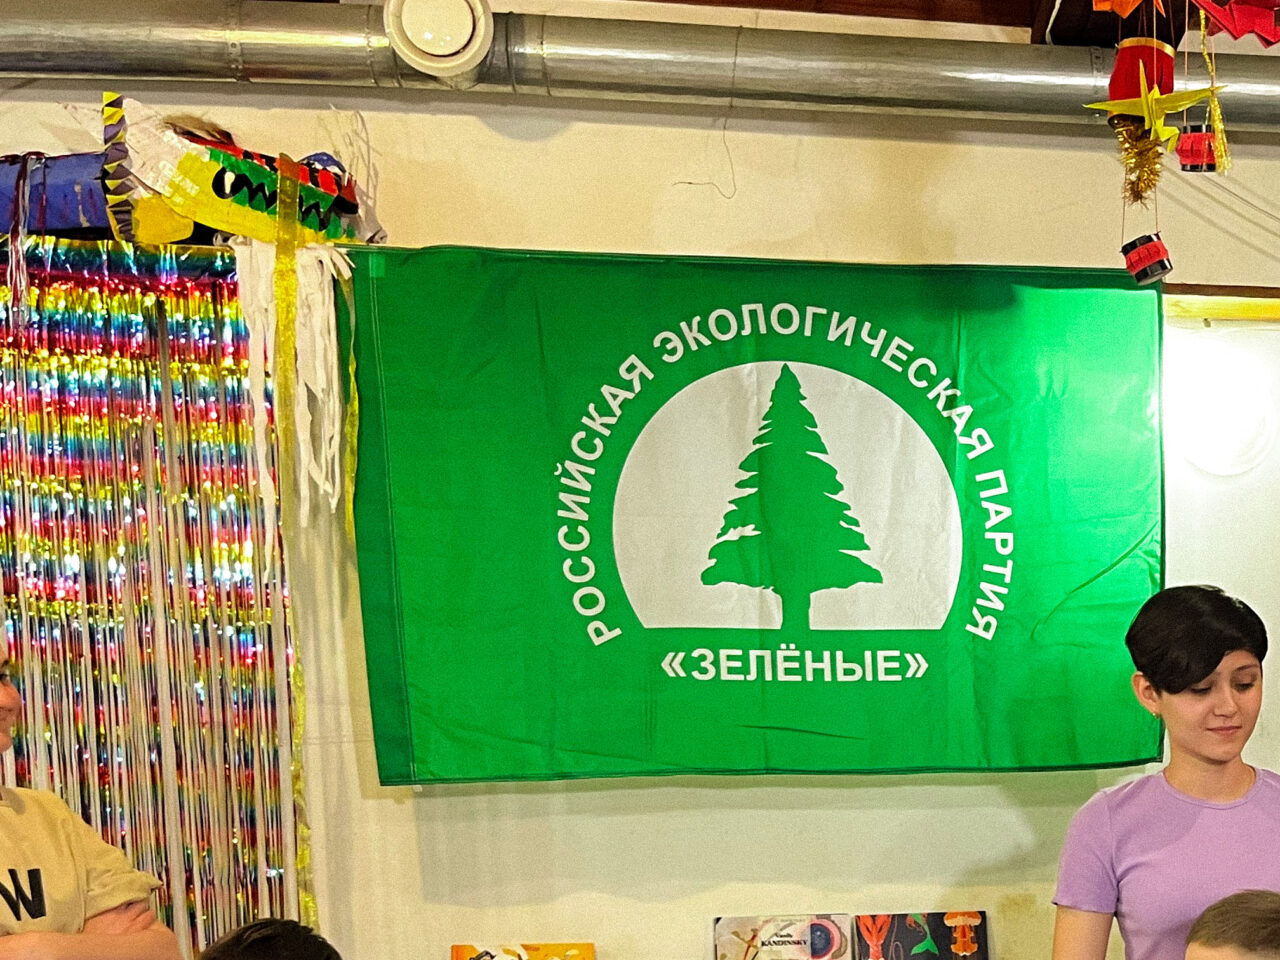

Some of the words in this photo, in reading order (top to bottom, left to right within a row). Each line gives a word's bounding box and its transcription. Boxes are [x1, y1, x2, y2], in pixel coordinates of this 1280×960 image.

[553, 353, 655, 647] РОССИЙСКАЯ
[652, 302, 995, 460] ЭКОЛОГИЧЕСКАЯ
[965, 468, 1015, 641] ПАРТИЯ
[660, 643, 929, 682] «ЗЕЛЁНЫЕ»
